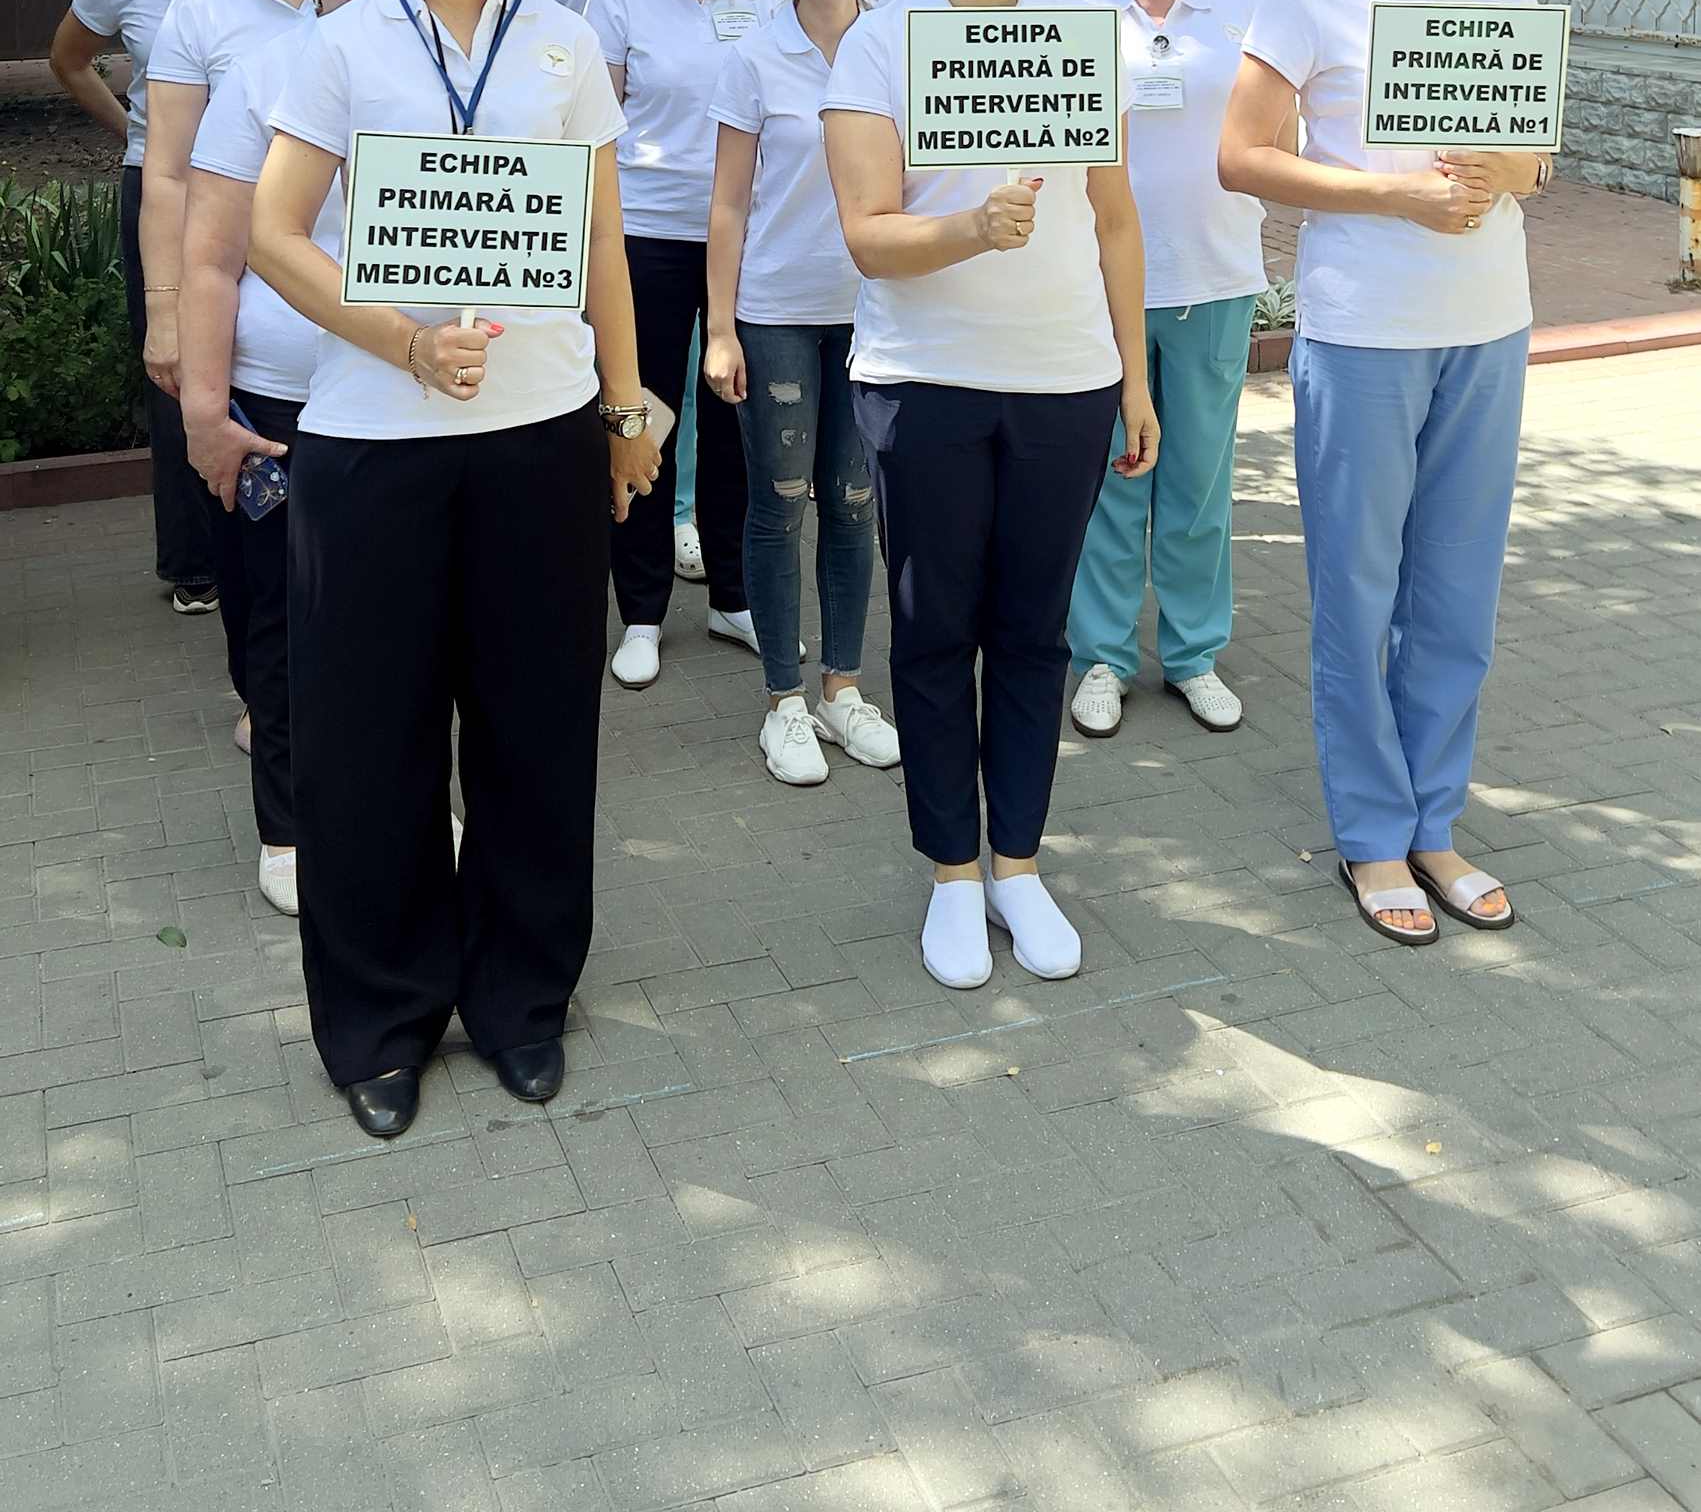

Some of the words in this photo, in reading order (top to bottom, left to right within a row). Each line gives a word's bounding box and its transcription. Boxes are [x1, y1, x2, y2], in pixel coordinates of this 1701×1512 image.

[965, 24, 1062, 44] ECHIPA
[1426, 19, 1515, 39] ECHIPA
[932, 54, 1053, 79] PRIMARĂ
[1062, 58, 1095, 77] DE
[1392, 49, 1504, 70] PRIMARĂ
[1512, 53, 1543, 71] DE
[925, 93, 1103, 119] INTERVENȚIE
[1384, 82, 1547, 106] INTERVENȚIE
[1375, 112, 1501, 134] MEDICALĂ
[918, 124, 1055, 150] MEDICALĂ
[420, 152, 528, 177] ECHIPA
[378, 188, 515, 213] PRIMARĂ
[525, 194, 563, 215] DE
[367, 225, 568, 257] INTERVENȚIE
[356, 262, 512, 288] MEDICALĂ
